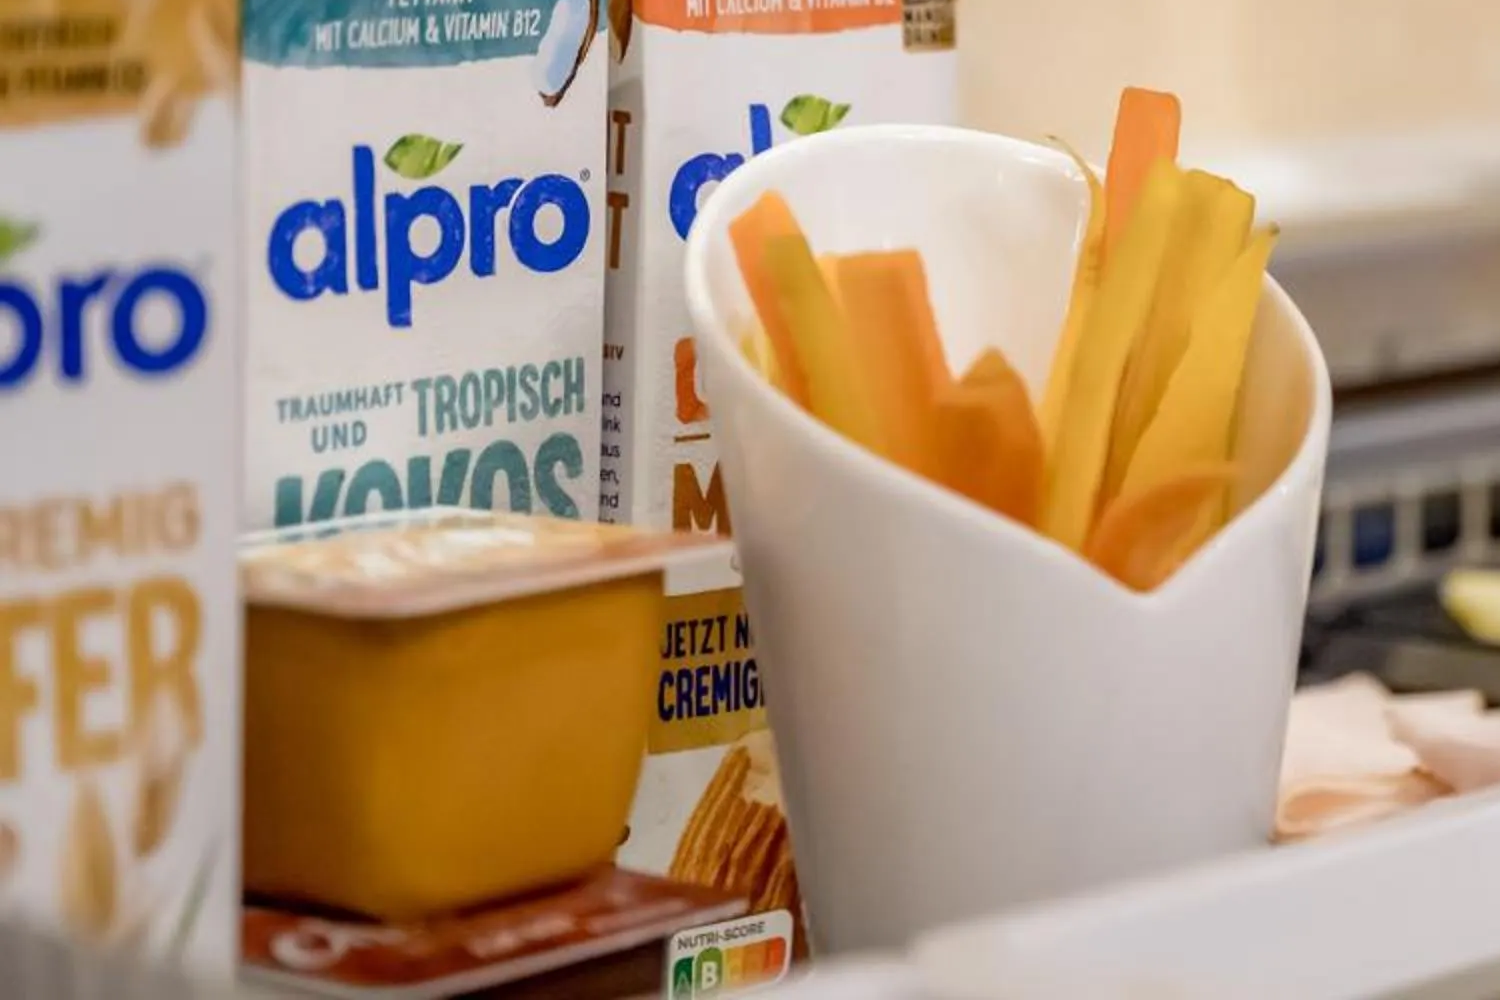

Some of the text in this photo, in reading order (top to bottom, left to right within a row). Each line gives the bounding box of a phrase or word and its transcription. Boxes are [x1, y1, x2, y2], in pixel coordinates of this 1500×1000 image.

[315, 8, 541, 51] MIT CALCIUM & VITAMIN B12
[267, 145, 591, 327] alpro
[277, 356, 585, 437] TRAUMHAFT TROPISCH
[311, 420, 368, 453] UND
[660, 614, 729, 659] JETZT
[657, 658, 766, 722] CREMIG
[677, 921, 766, 950] NUTRI-SCORE
